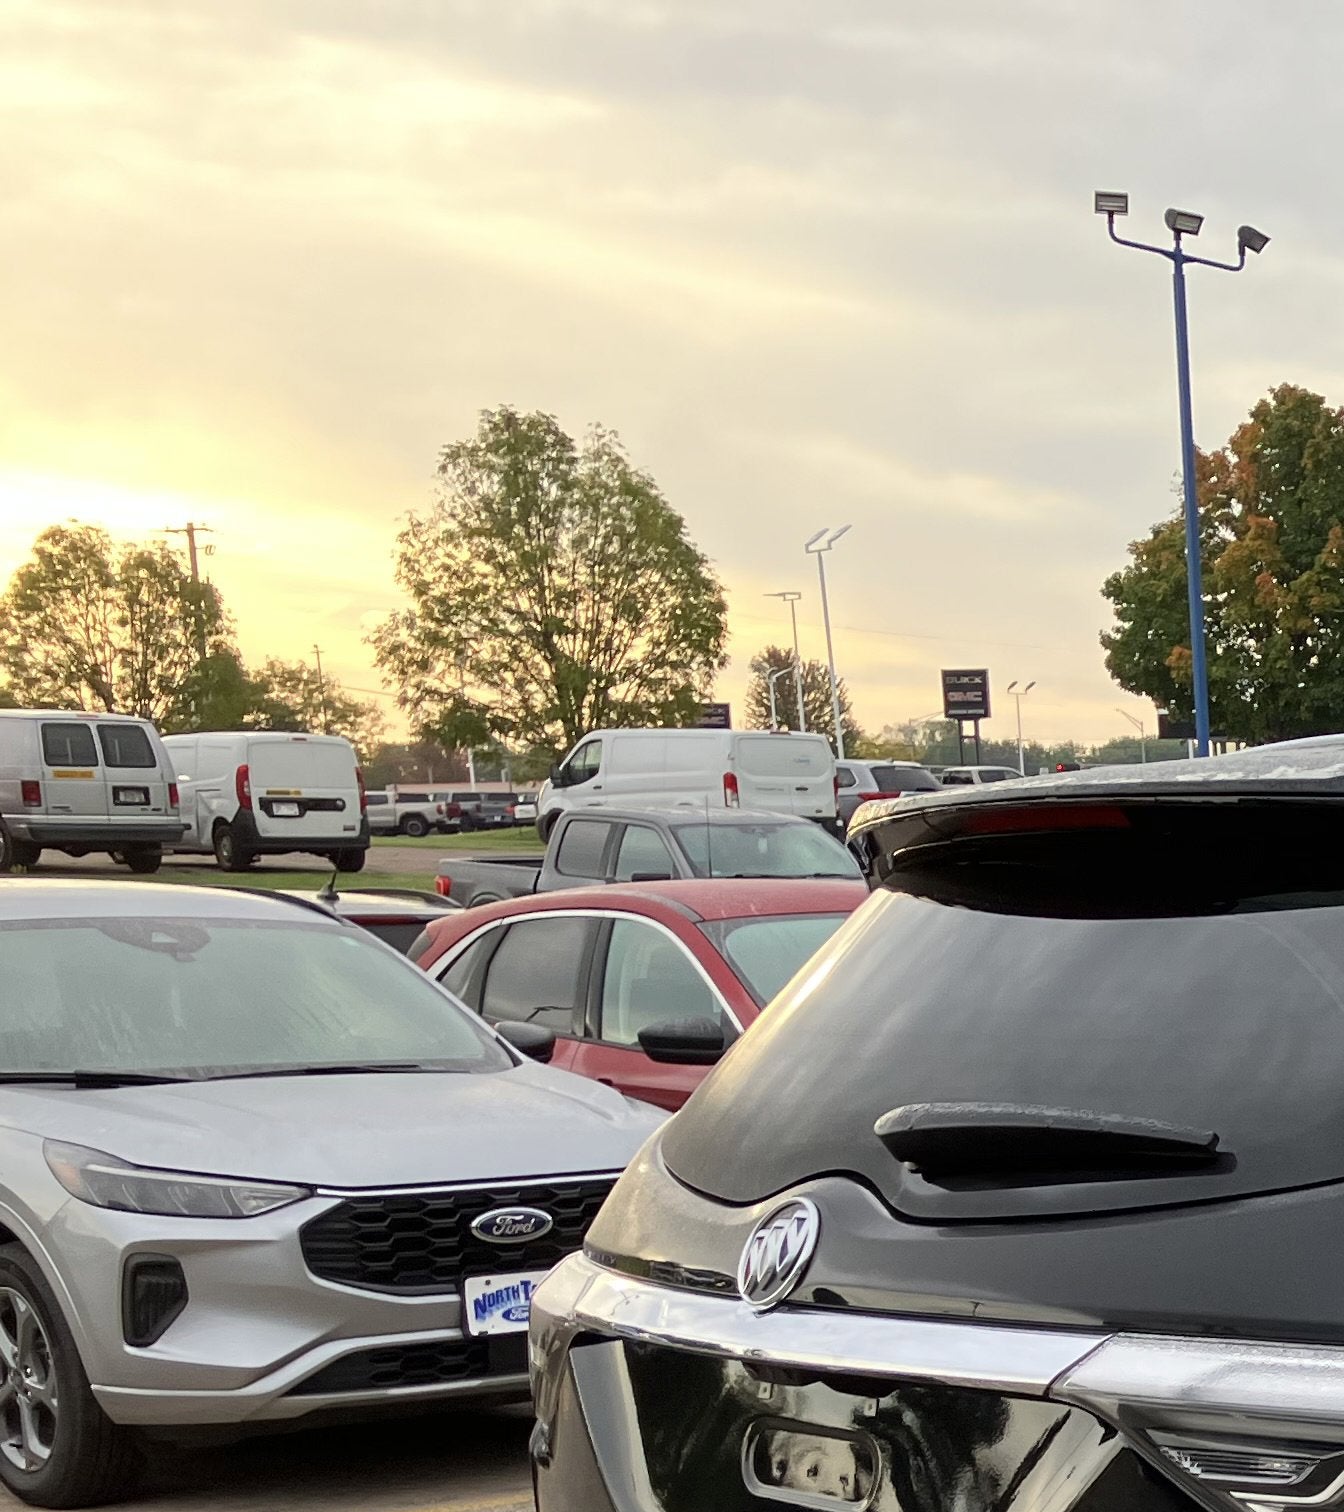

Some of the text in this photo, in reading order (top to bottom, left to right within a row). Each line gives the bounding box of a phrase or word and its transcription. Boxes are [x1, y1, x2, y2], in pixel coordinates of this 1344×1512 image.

[945, 676, 983, 684] BUICK
[947, 691, 983, 701] GMC
[492, 1215, 535, 1235] Ford
[473, 1284, 520, 1320] NORTH
